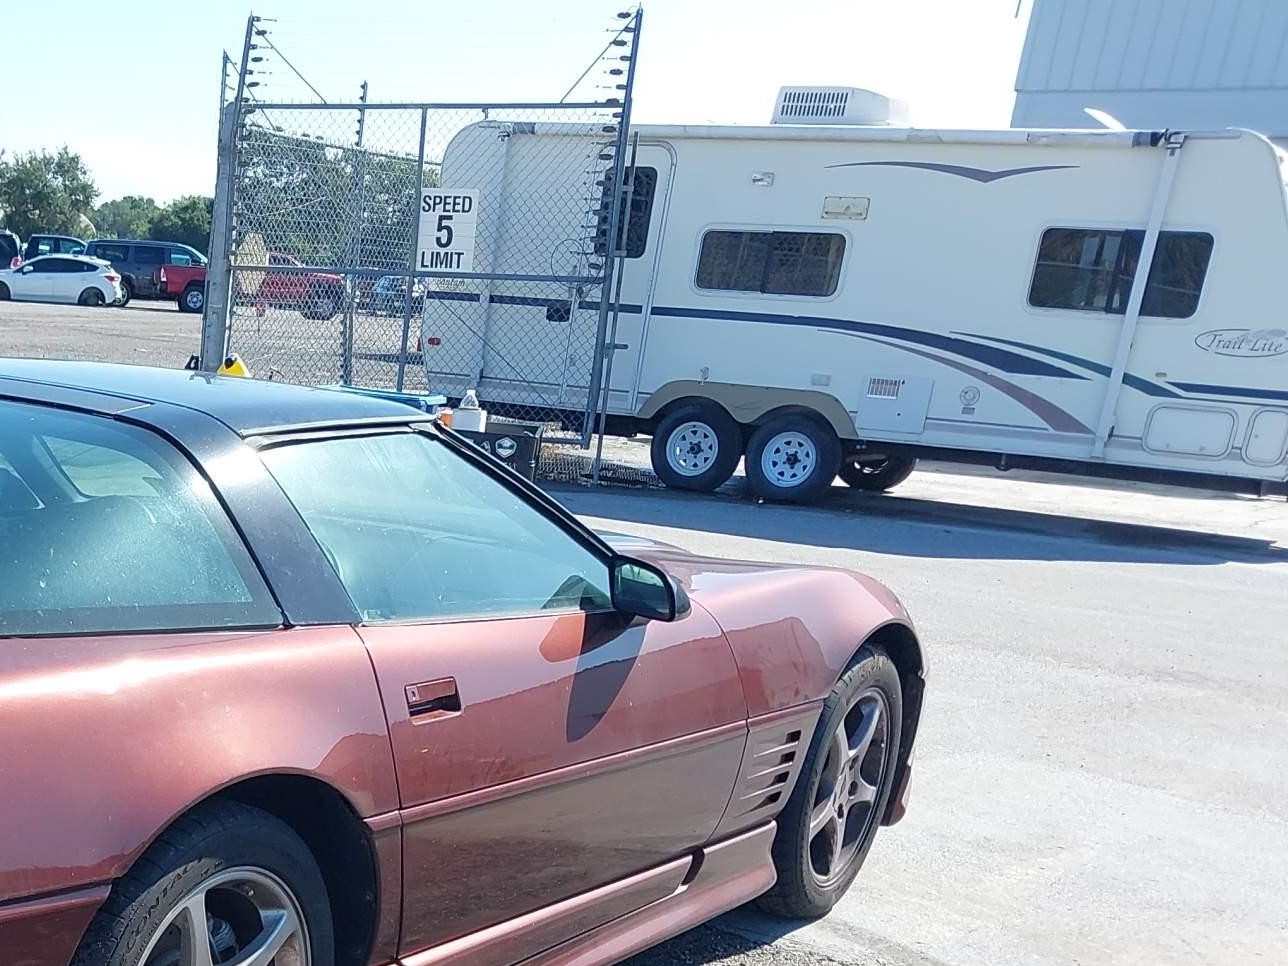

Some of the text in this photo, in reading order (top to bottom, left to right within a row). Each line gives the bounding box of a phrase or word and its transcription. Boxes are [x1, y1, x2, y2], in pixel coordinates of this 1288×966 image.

[422, 195, 473, 213] SPEED
[435, 214, 454, 248] 5
[420, 251, 464, 269] LIMIT
[1207, 334, 1283, 353] Trail Lite
